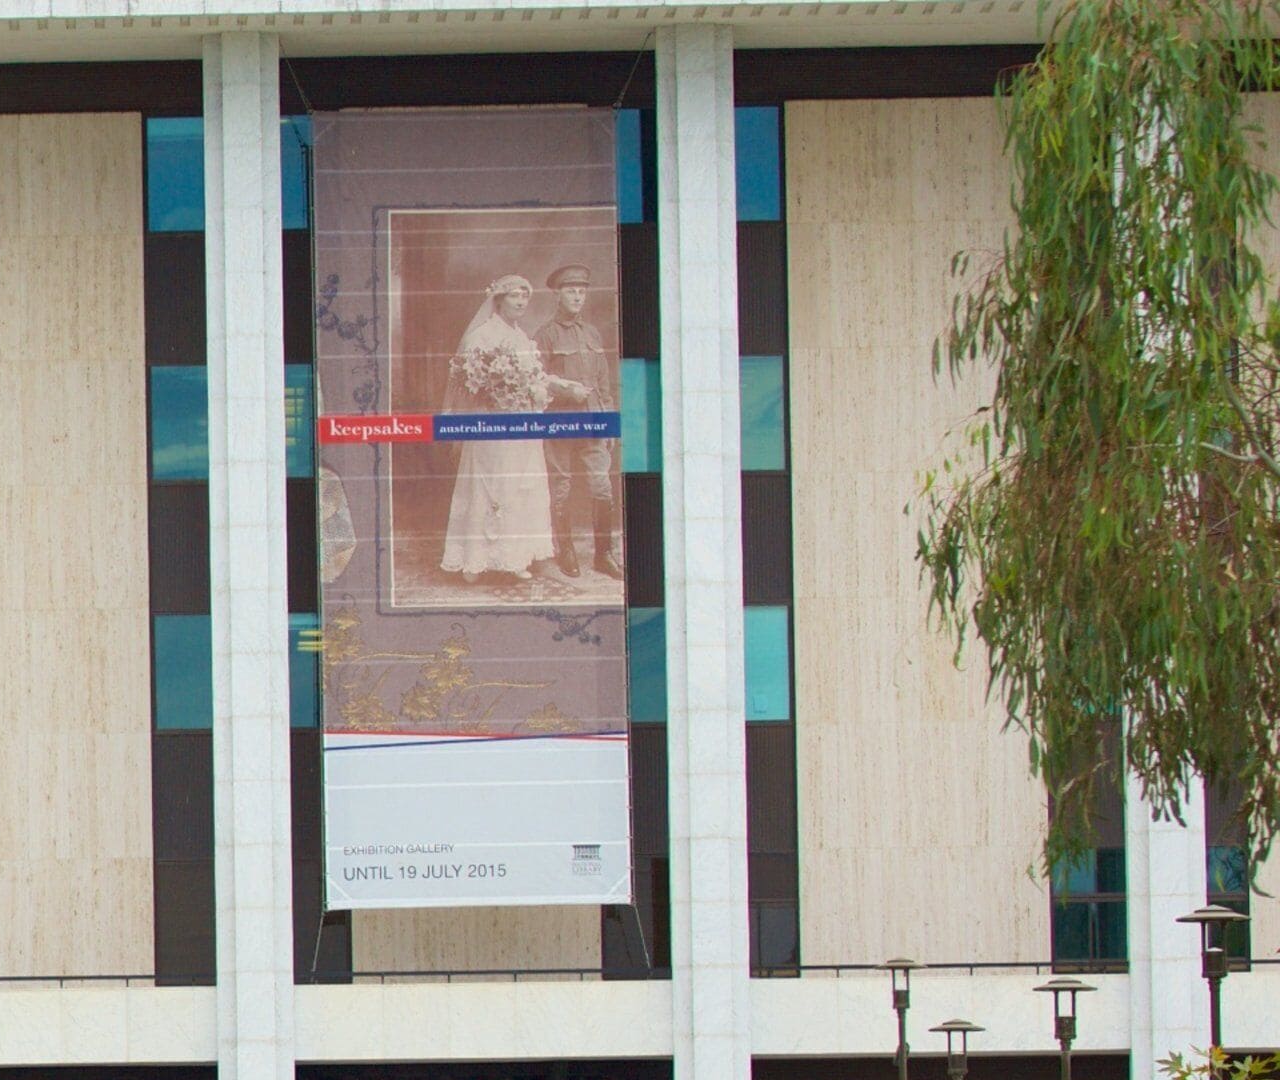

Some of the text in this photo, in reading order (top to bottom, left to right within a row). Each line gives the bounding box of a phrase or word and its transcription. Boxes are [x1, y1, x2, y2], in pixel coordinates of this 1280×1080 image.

[330, 418, 608, 440] keepsakes australians and the great war
[343, 843, 455, 855] EXHIBITION GALLERY
[343, 863, 507, 881] UNTIL 19 JULY 2015
